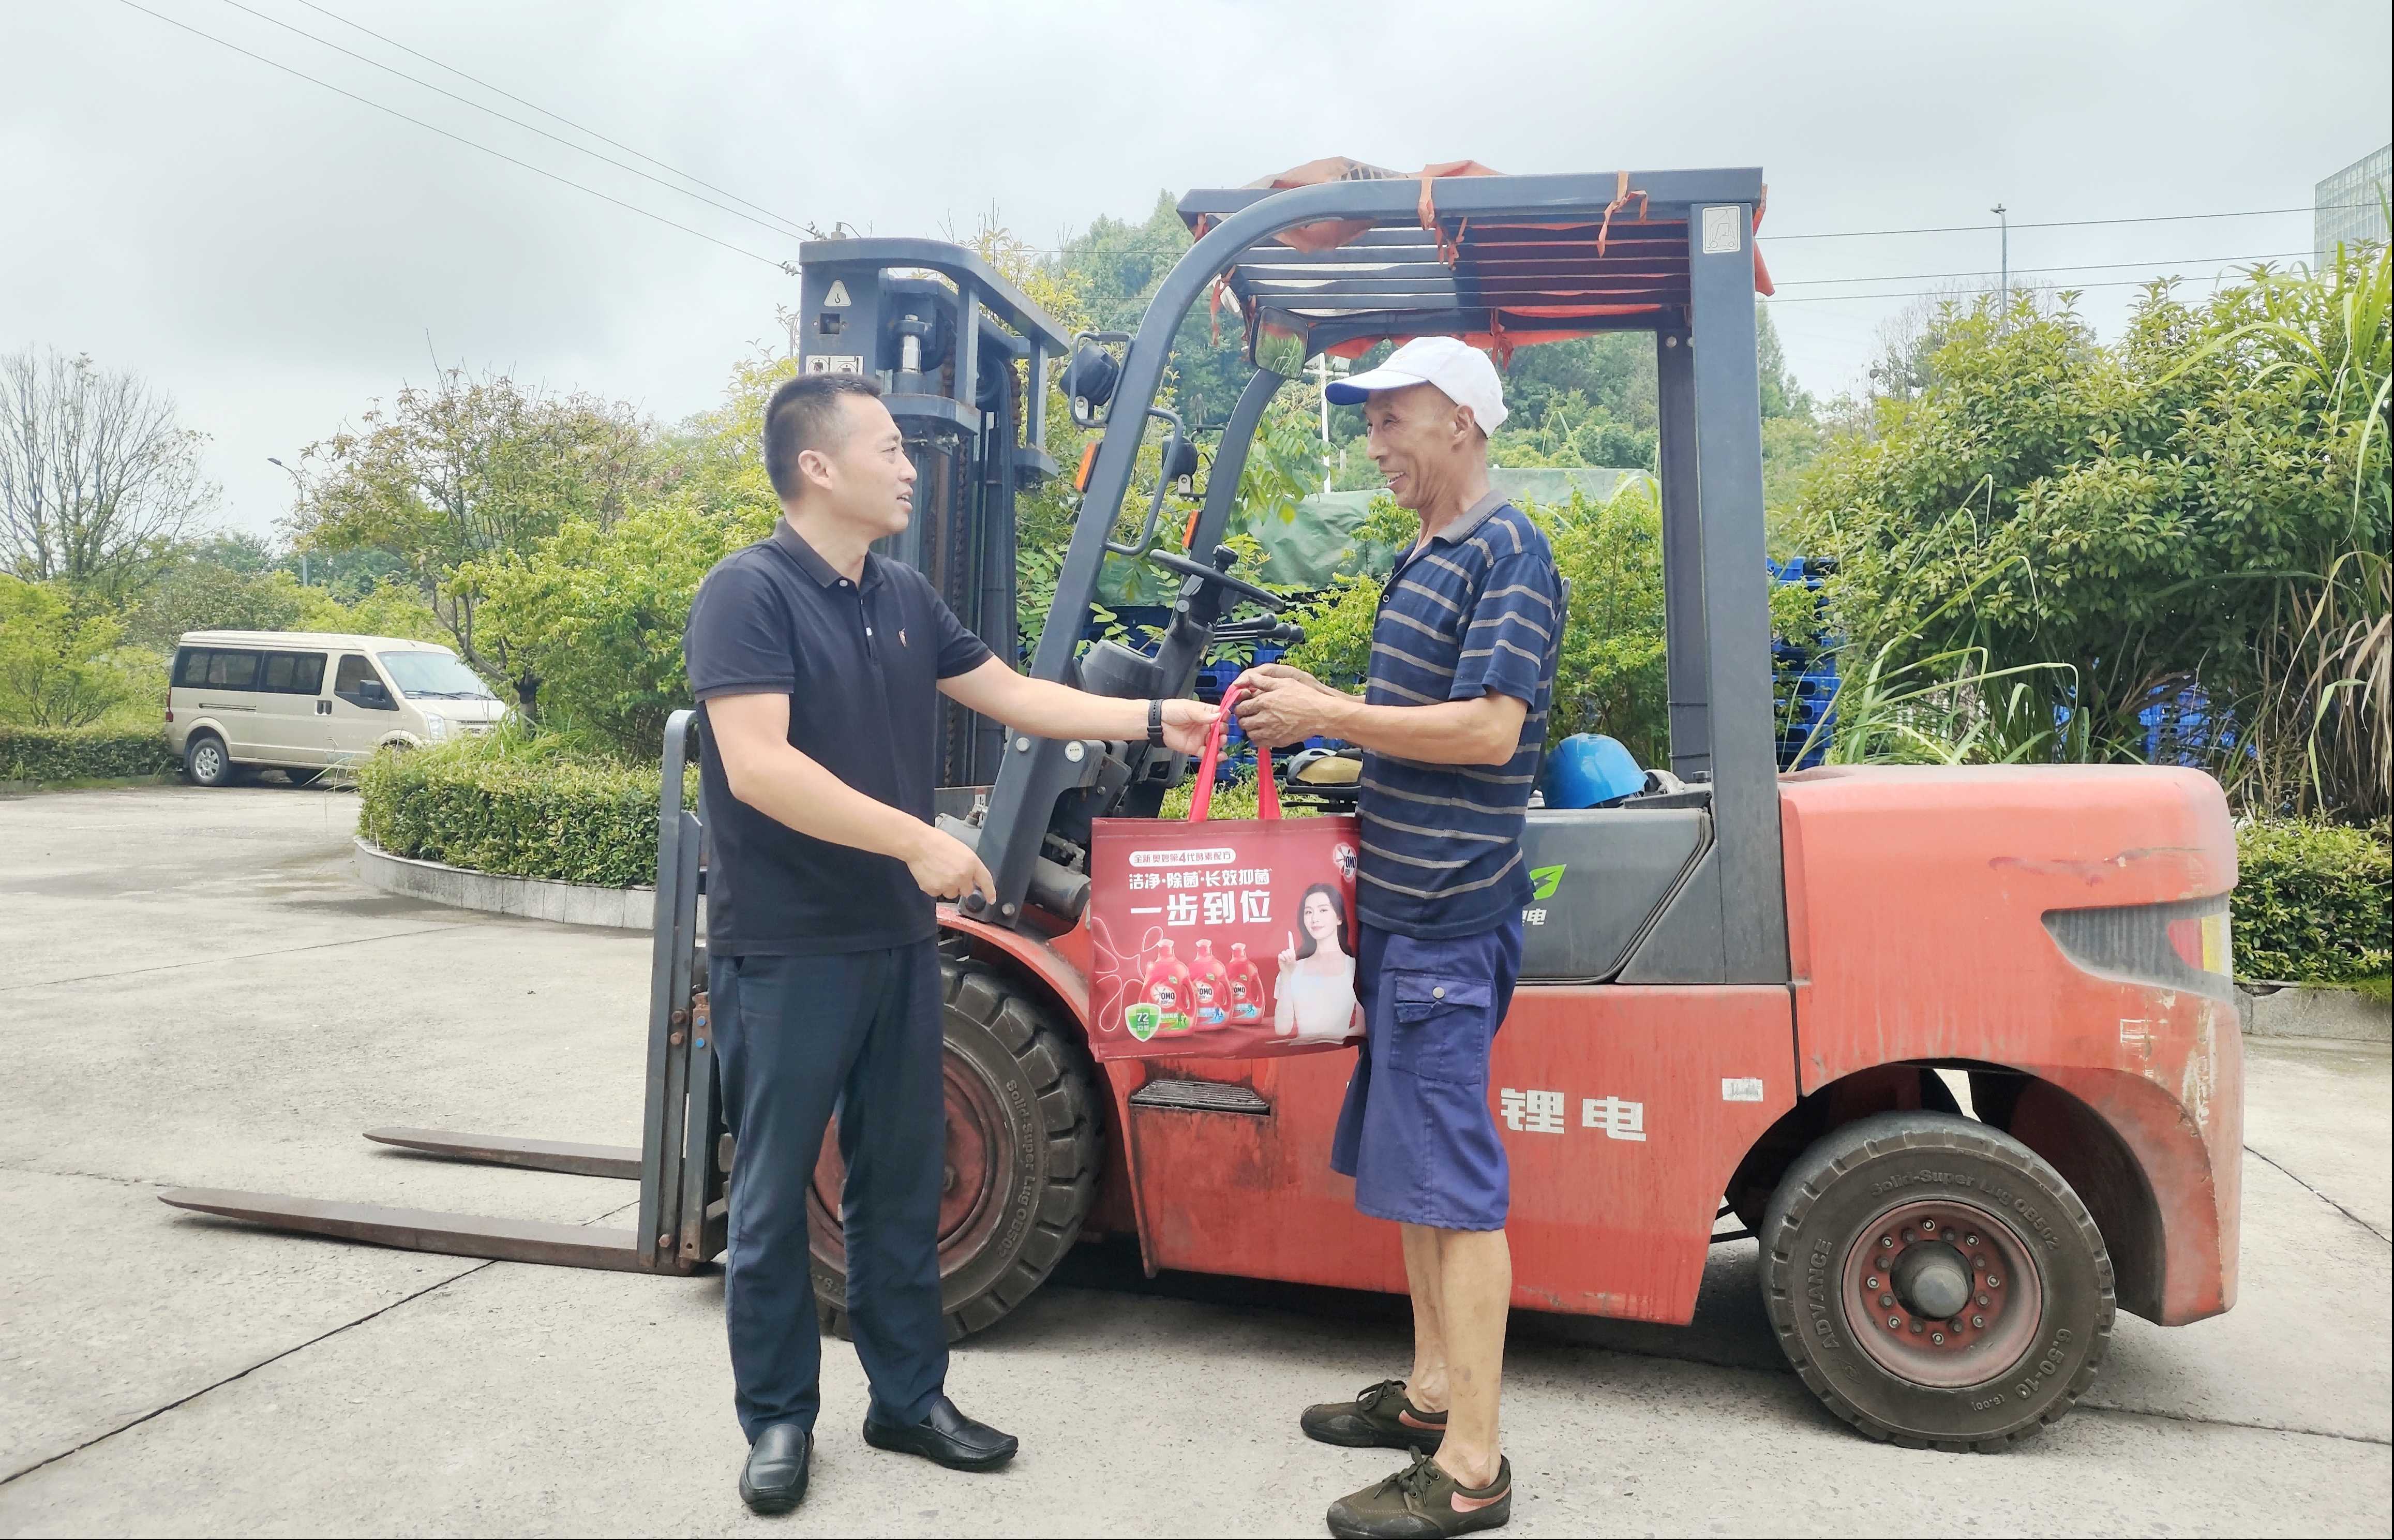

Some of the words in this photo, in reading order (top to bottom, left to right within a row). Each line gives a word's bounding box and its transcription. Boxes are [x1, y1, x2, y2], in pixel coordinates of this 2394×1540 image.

[1345, 856, 1356, 868] OMO
[1130, 889, 1273, 926] 一步到位
[1136, 1012, 1149, 1022] 72
[1006, 1079, 1034, 1171] Solid-Super
[1501, 1087, 1647, 1142] 锂电
[1018, 1176, 1035, 1206] Lug
[1871, 1169, 1975, 1197] Solid-Super
[1808, 1238, 1841, 1349] ADVANCE
[2014, 1328, 2072, 1399] 6.50-10
